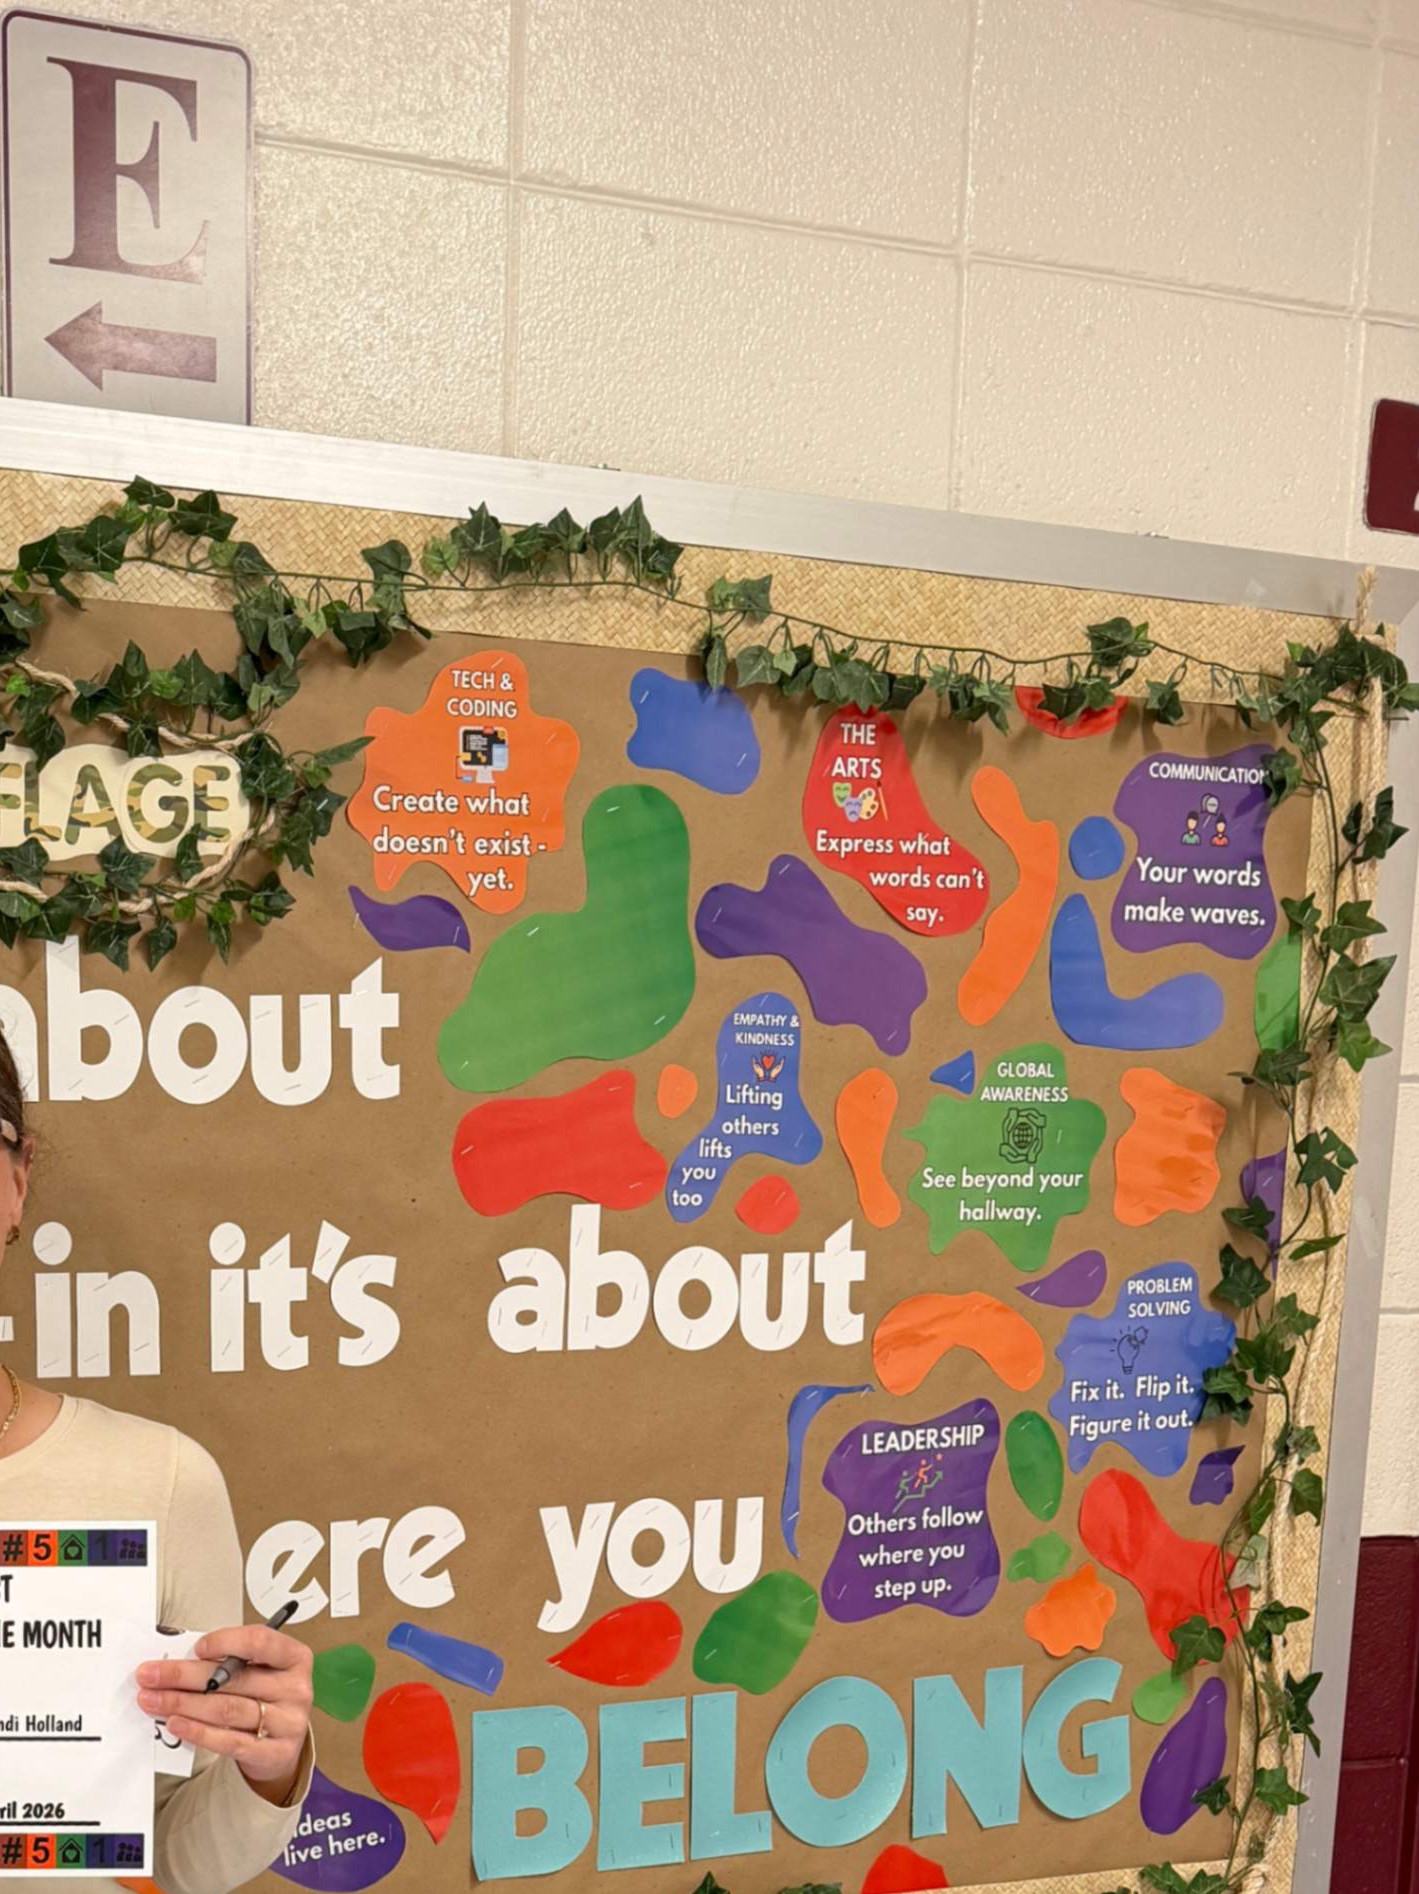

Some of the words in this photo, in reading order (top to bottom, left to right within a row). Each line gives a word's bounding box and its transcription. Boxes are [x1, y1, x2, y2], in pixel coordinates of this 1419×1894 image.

[46, 56, 210, 285] E
[452, 670, 495, 690] TECH
[499, 672, 515, 691] &
[446, 698, 518, 718] CODING
[840, 722, 877, 746] THE
[831, 756, 883, 779] ARTS
[372, 785, 459, 813] Create
[466, 788, 530, 816] what
[372, 825, 466, 854] doesn't
[474, 831, 532, 856] exist
[816, 829, 894, 858] Express
[900, 832, 951, 856] what
[468, 868, 514, 896] yet.
[869, 865, 931, 888] words
[935, 868, 985, 890] can't
[1136, 856, 1188, 884] Your
[1193, 860, 1262, 888] words
[906, 906, 944, 928] say.
[1124, 896, 1185, 923] make
[1190, 907, 1266, 926] waves.
[733, 1013, 787, 1027] EMPATHY
[789, 1015, 800, 1028] &
[735, 1032, 795, 1046] KINDNESS
[996, 1062, 1055, 1078] GLOBAL
[726, 1084, 783, 1110] Lifting
[980, 1086, 1069, 1102] AWARENESS
[721, 1115, 779, 1135] others
[699, 1138, 732, 1158] lifts
[682, 1166, 716, 1185] you
[922, 1167, 956, 1188] See
[961, 1166, 1034, 1193] beyond
[1039, 1173, 1084, 1193] your
[672, 1189, 703, 1206] too
[959, 1199, 1042, 1226] hallway.
[209, 1219, 401, 1372] it's
[487, 1203, 866, 1353] about
[1127, 1277, 1193, 1295] PROBLEM
[1128, 1300, 1191, 1318] SOLVING
[1070, 1380, 1100, 1402] Fix
[1105, 1379, 1125, 1400] it.
[1136, 1375, 1171, 1402] Flip
[1175, 1373, 1195, 1394] it.
[1069, 1414, 1132, 1441] Figure
[1137, 1410, 1150, 1431] it
[1155, 1410, 1194, 1429] out.
[861, 1424, 985, 1455] LEADERSHIP
[847, 1512, 916, 1536] Others
[922, 1505, 983, 1529] follow
[245, 1505, 466, 1624] ere
[536, 1496, 764, 1633] you
[859, 1544, 924, 1567] where
[929, 1544, 965, 1567] you
[874, 1580, 916, 1601] step
[921, 1578, 952, 1598] up.
[23, 1619, 102, 1648] MONTH
[25, 1714, 82, 1732] Holland
[471, 1656, 1132, 1882] BELONG
[22, 1802, 65, 1819] 2026
[284, 1844, 323, 1867] live
[328, 1831, 386, 1856] here.
